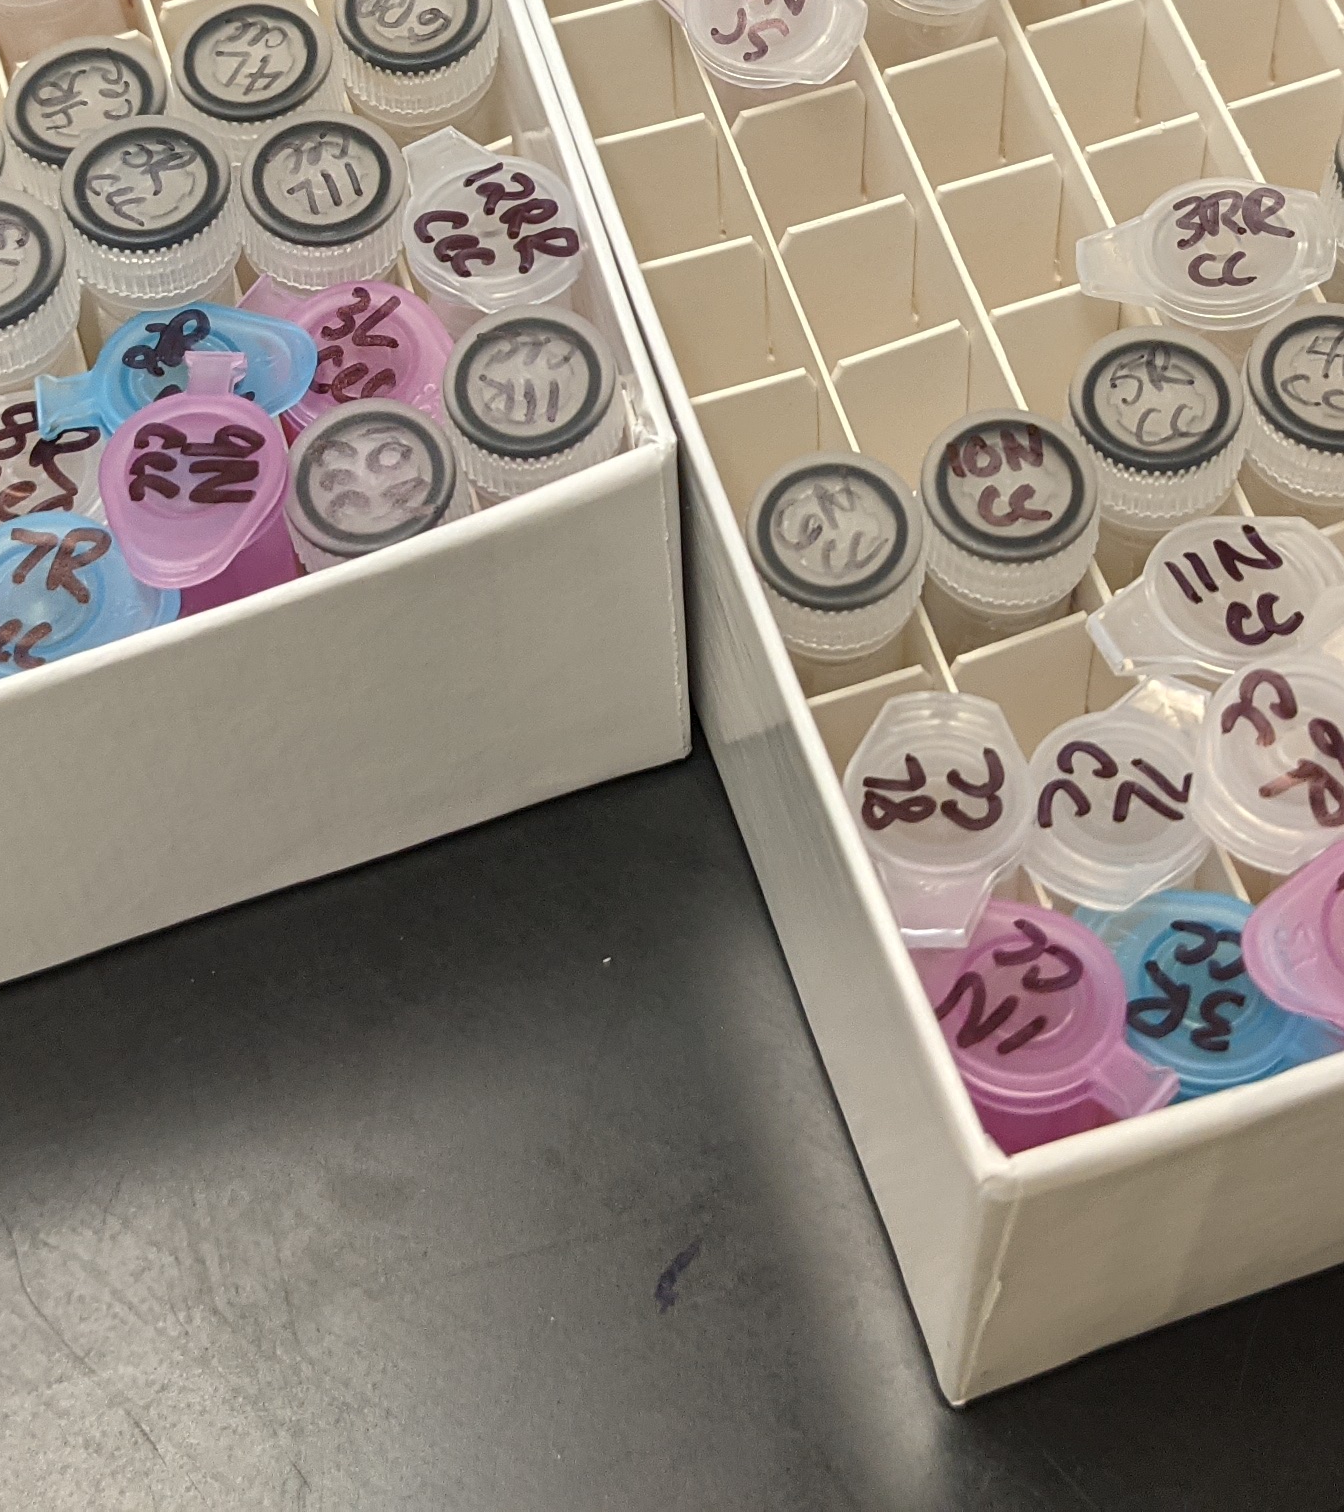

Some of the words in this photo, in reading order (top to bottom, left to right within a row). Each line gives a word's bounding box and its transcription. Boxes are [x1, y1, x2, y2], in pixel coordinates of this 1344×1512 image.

[1172, 188, 1296, 248] 3RR
[1188, 251, 1258, 288] CC
[946, 422, 1045, 481] 10N
[10, 527, 112, 604] 7R
[1164, 524, 1284, 604] 11N
